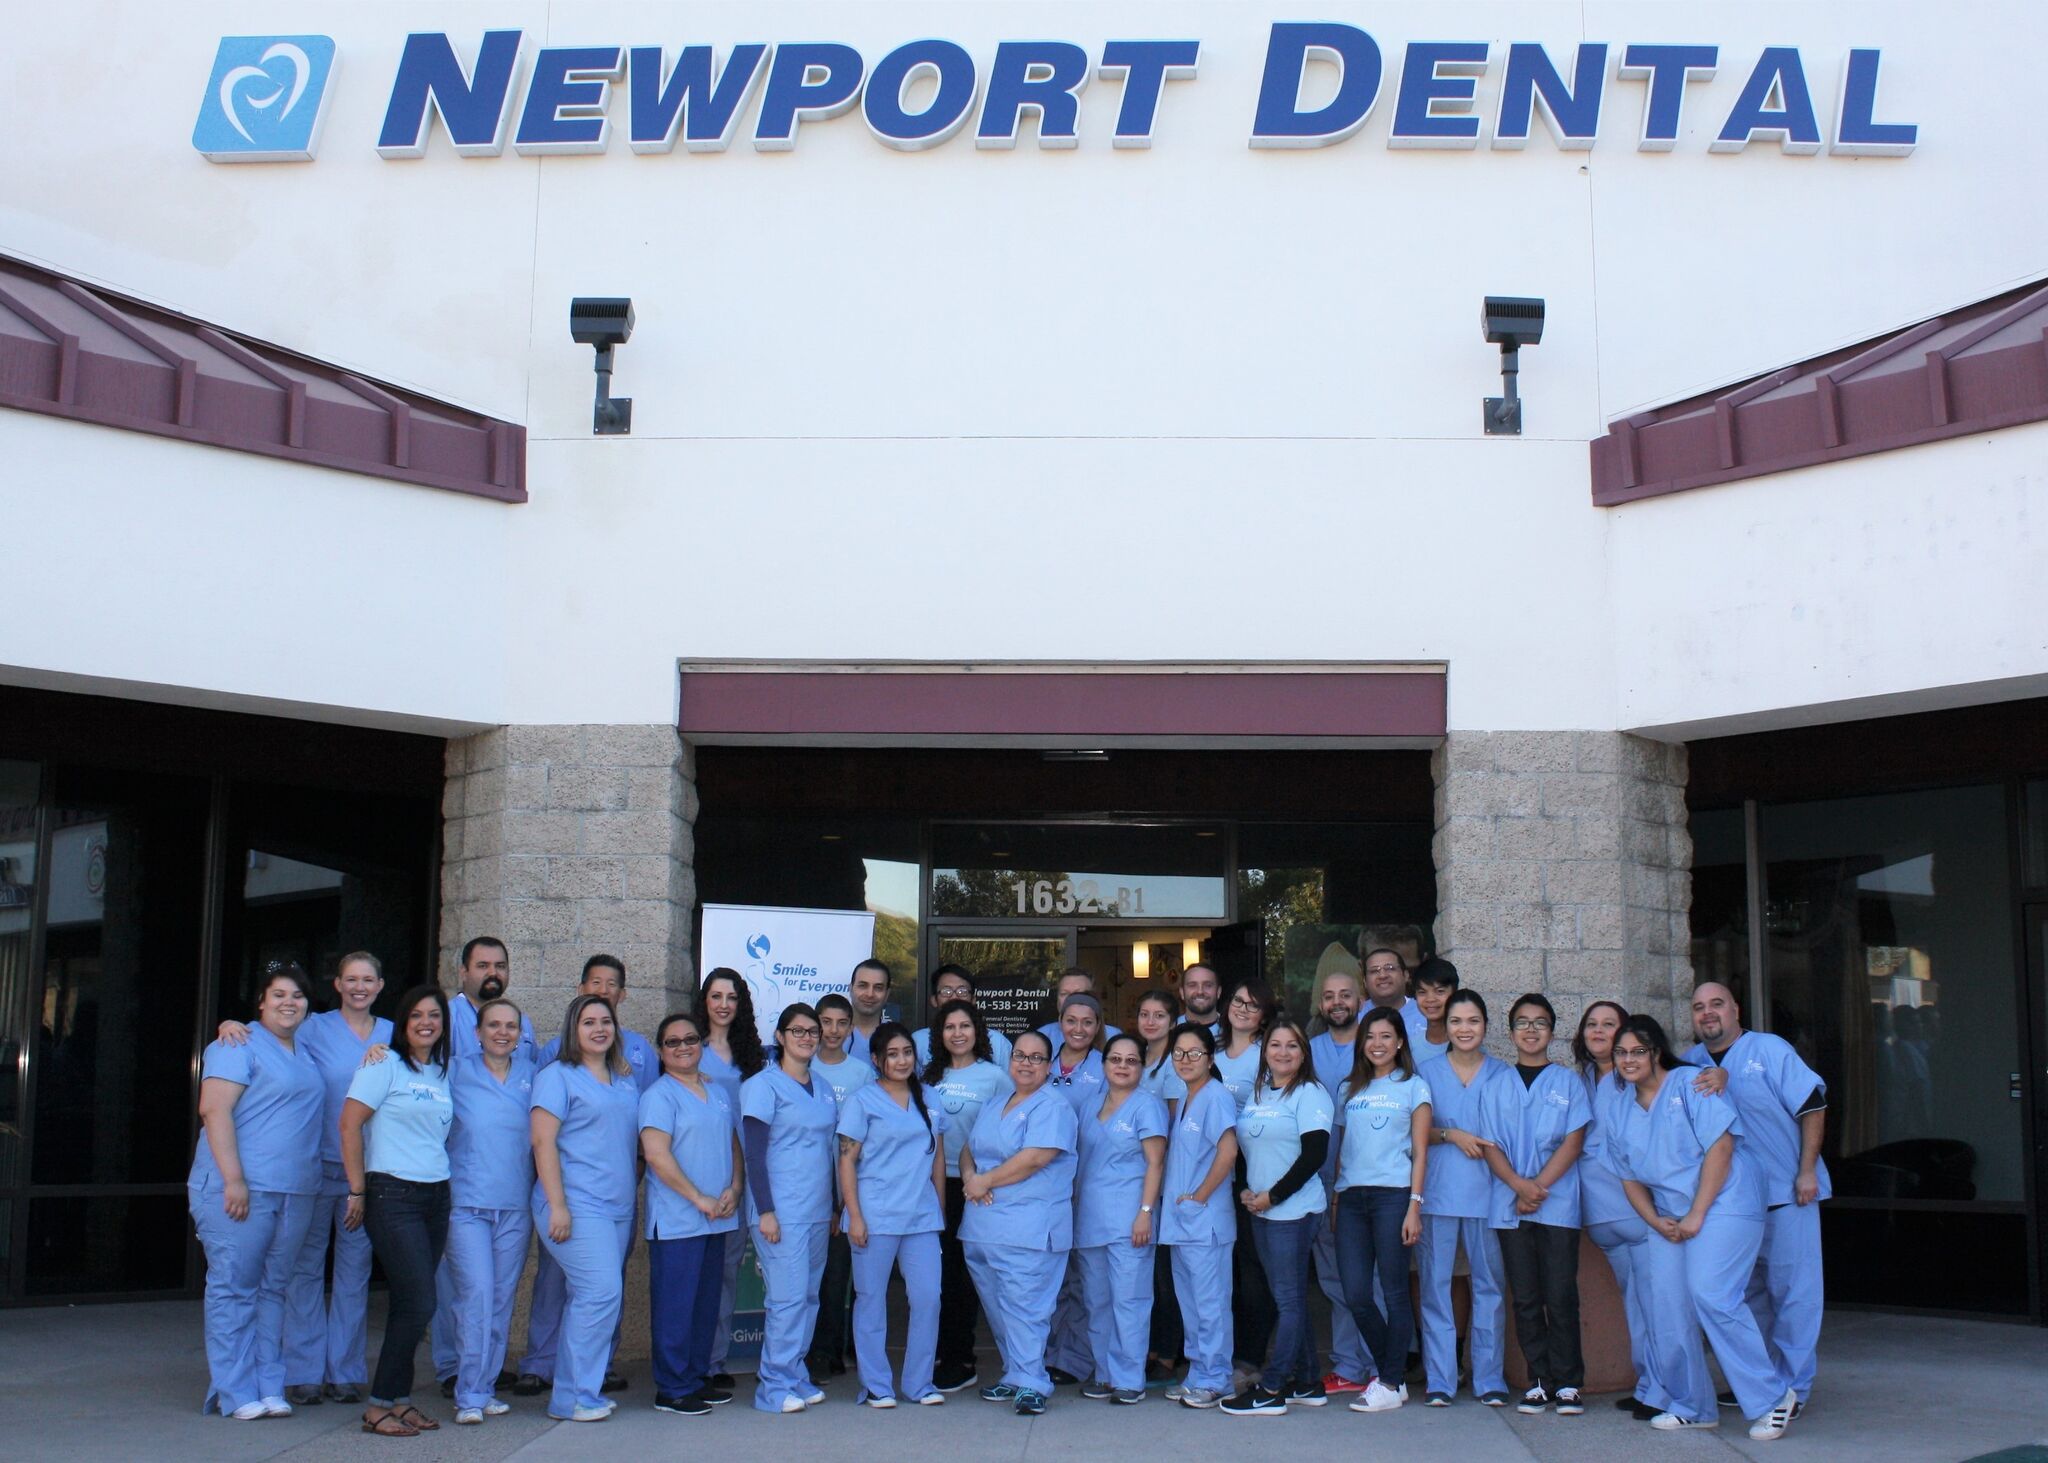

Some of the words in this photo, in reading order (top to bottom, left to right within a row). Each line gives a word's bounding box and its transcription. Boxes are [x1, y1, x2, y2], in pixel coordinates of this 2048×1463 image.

[377, 28, 1199, 151] NEWPORT
[1250, 20, 1921, 156] DENTAL
[772, 962, 818, 977] Smiles
[784, 977, 799, 987] for
[798, 980, 850, 994] Everyon
[1015, 988, 1050, 997] Dental
[976, 1000, 1039, 1010] 14-538-2311
